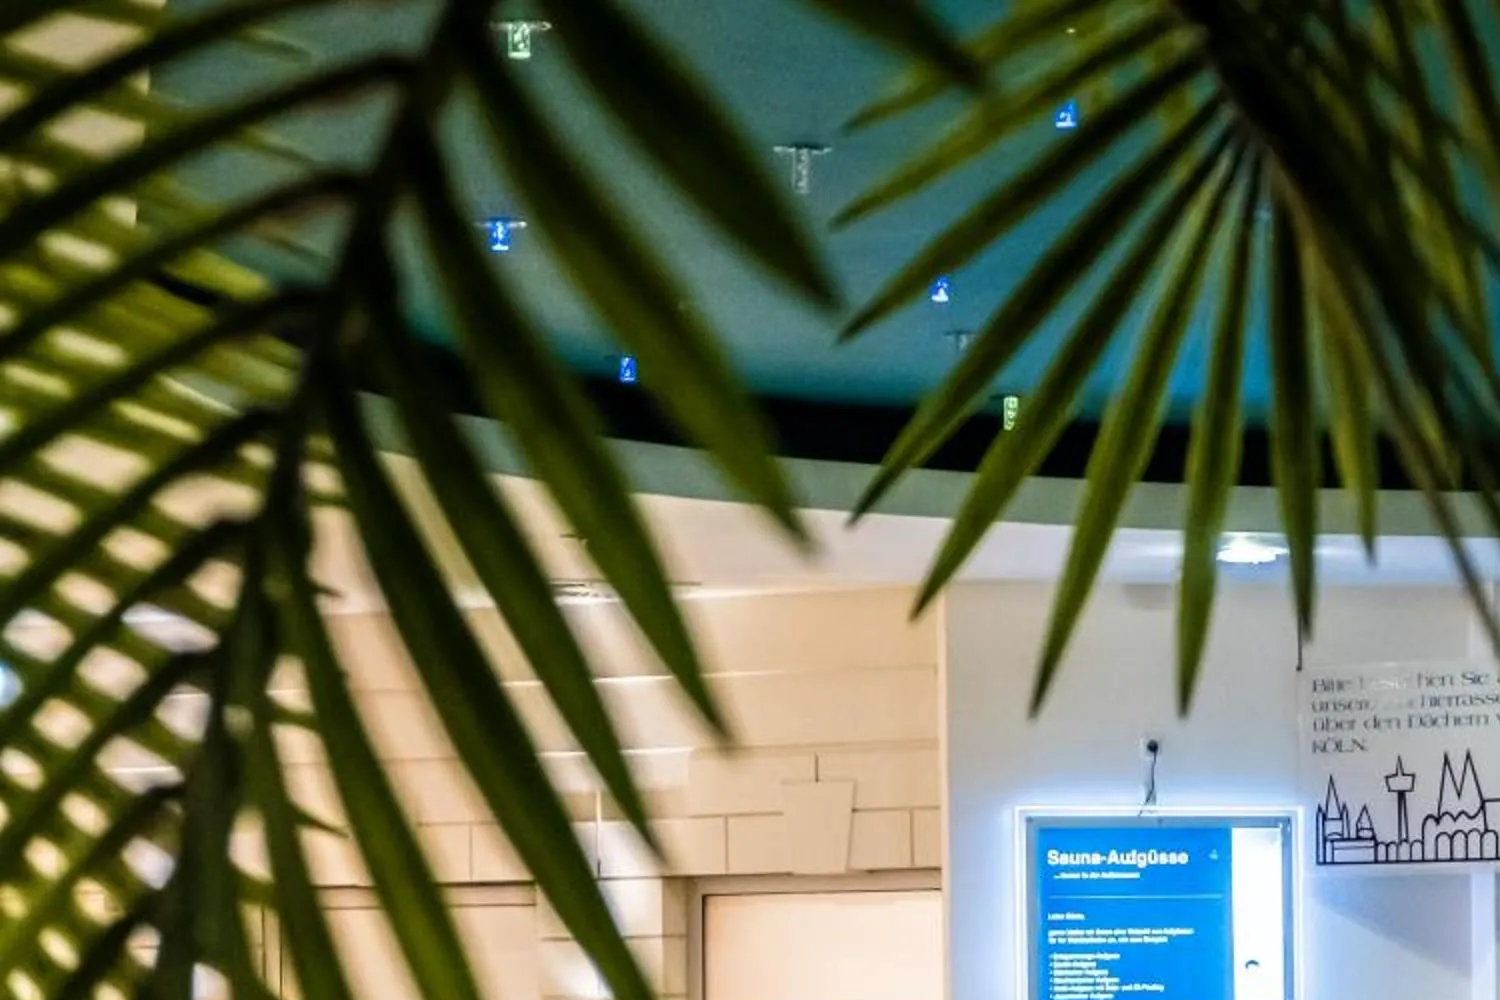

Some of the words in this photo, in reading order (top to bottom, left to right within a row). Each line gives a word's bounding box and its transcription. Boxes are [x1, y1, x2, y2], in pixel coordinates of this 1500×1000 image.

[1460, 671, 1490, 686] Sie
[1311, 698, 1374, 713] unser
[1312, 715, 1356, 732] über
[1363, 713, 1401, 730] den
[1406, 709, 1490, 729] Dächern
[1311, 736, 1368, 754] KÖLN
[1047, 849, 1189, 868] Sauna-Aufgüsse
